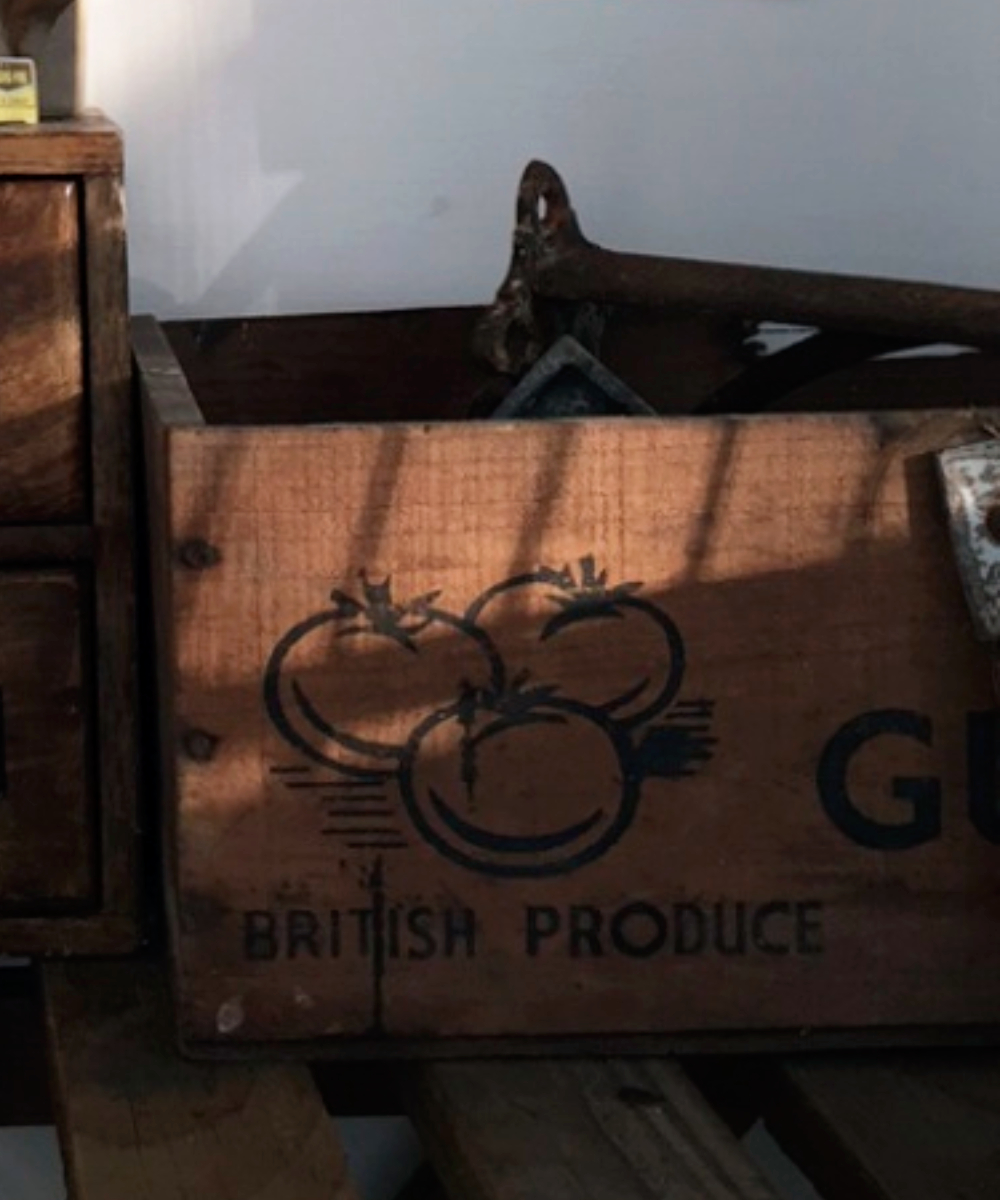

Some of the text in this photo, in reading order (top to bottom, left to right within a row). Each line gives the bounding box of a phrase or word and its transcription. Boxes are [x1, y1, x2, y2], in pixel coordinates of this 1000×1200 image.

[816, 707, 1000, 850] G
[242, 900, 827, 963] BRITISH PRODUCE
